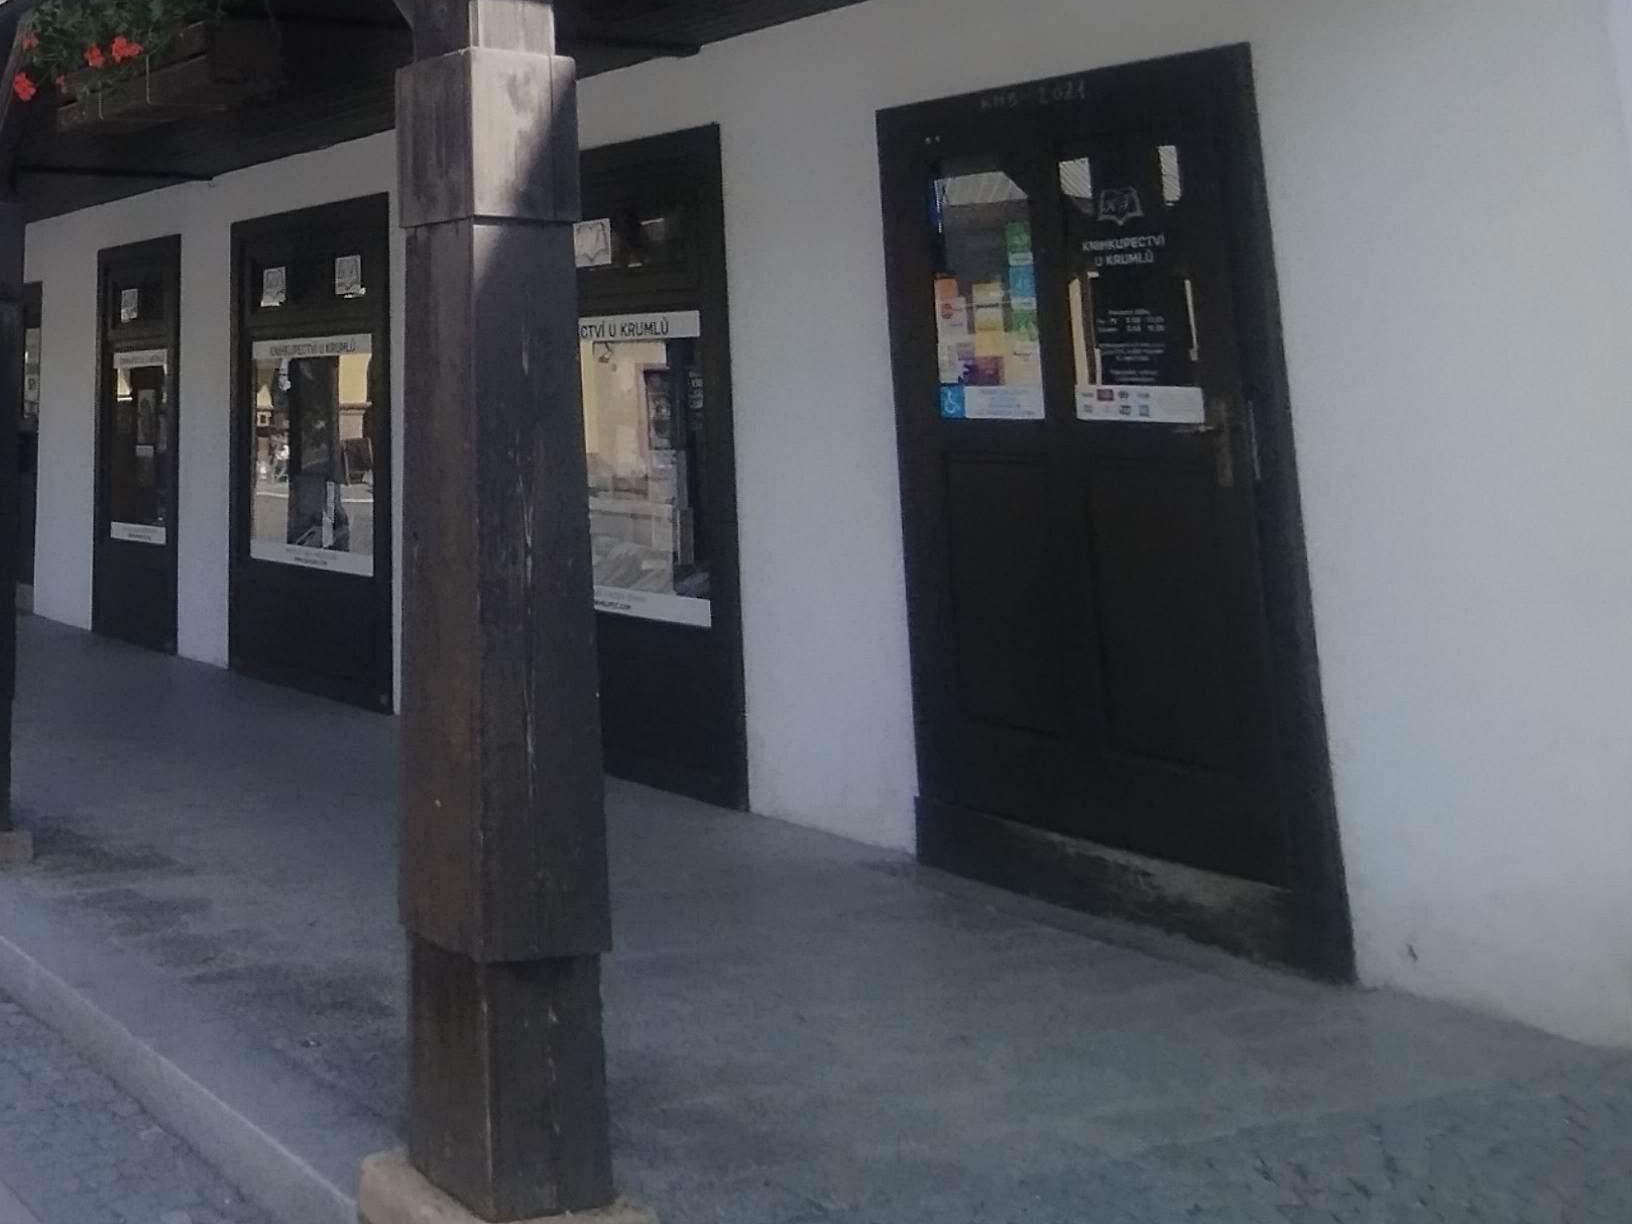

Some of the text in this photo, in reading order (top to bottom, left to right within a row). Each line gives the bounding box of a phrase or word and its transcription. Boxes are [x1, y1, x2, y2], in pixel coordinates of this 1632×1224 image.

[1094, 255, 1104, 267] U
[580, 316, 669, 339] CTVÍ U KRUMLŮ
